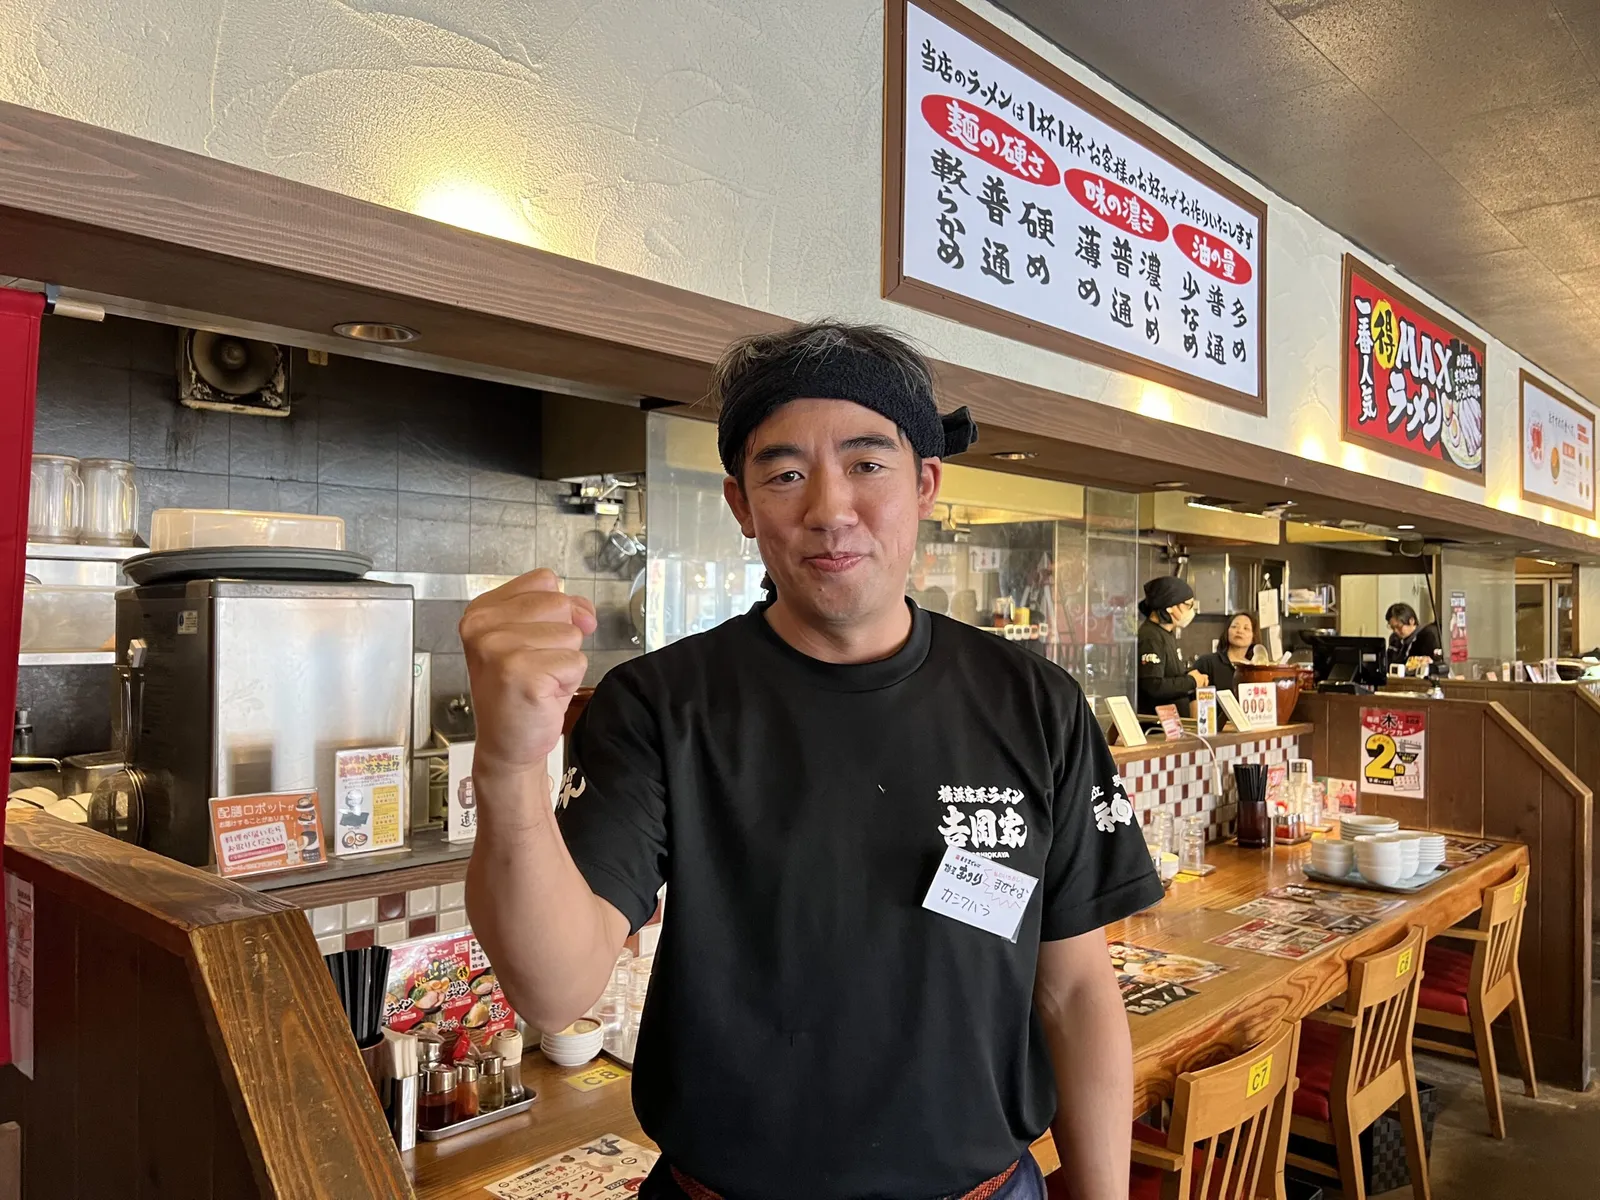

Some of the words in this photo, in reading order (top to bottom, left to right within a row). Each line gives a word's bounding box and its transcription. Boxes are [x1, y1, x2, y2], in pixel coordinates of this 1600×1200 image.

[945, 99, 1047, 180] 麺の硬さ
[976, 174, 1015, 285] 普通
[1017, 200, 1056, 285] 硬め
[1082, 178, 1156, 234] 味の濃さ
[1074, 224, 1102, 308] 薄め
[1109, 235, 1134, 329] 普通
[1138, 250, 1163, 345] 濃いめ
[1191, 234, 1236, 280] 油の量
[1178, 270, 1201, 359] 少なめ
[1204, 284, 1227, 366] 普通
[1230, 297, 1248, 362] 多め
[1354, 298, 1377, 423] 一番人気
[1396, 320, 1452, 393] MAX
[1387, 371, 1441, 443] ラーメン
[937, 784, 1026, 805] 横浜家系ラーメン
[1252, 1066, 1268, 1091] C7
